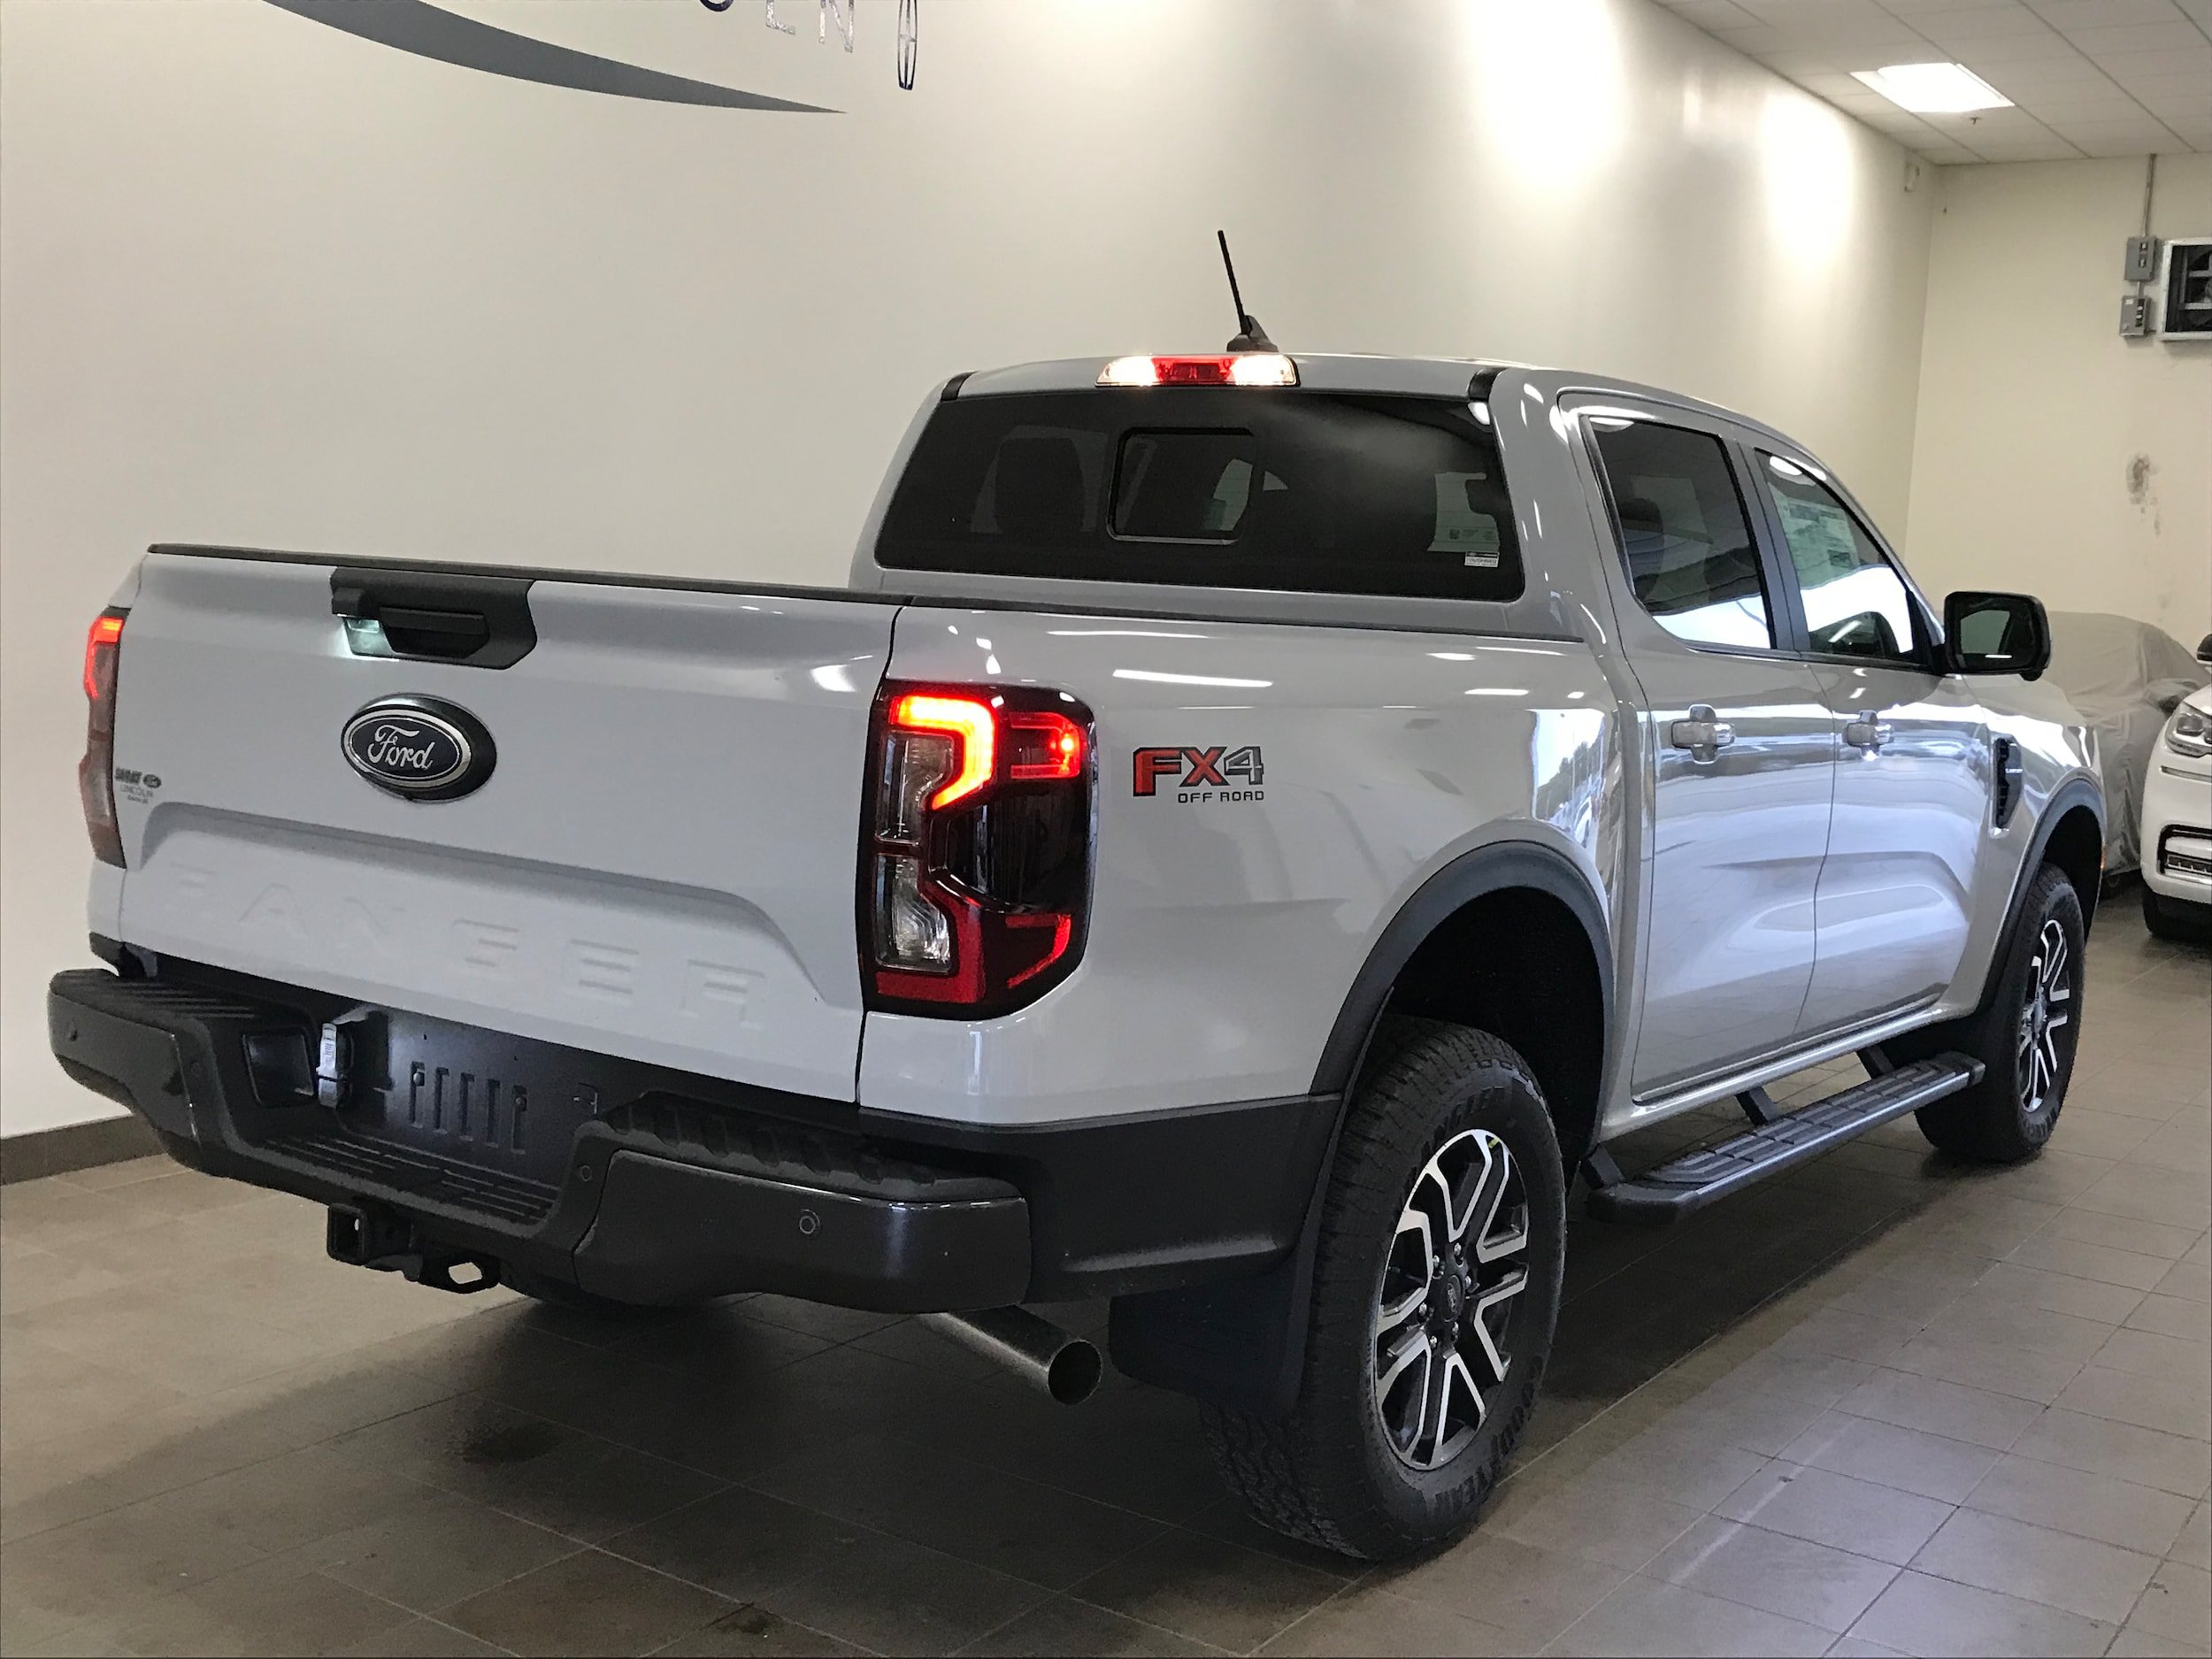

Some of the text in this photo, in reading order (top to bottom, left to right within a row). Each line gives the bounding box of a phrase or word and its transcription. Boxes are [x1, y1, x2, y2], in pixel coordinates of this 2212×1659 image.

[367, 724, 434, 771] Ford
[1133, 746, 1263, 797] FX4
[1178, 790, 1264, 803] OFF ROAD
[165, 862, 768, 1030] RANGER
